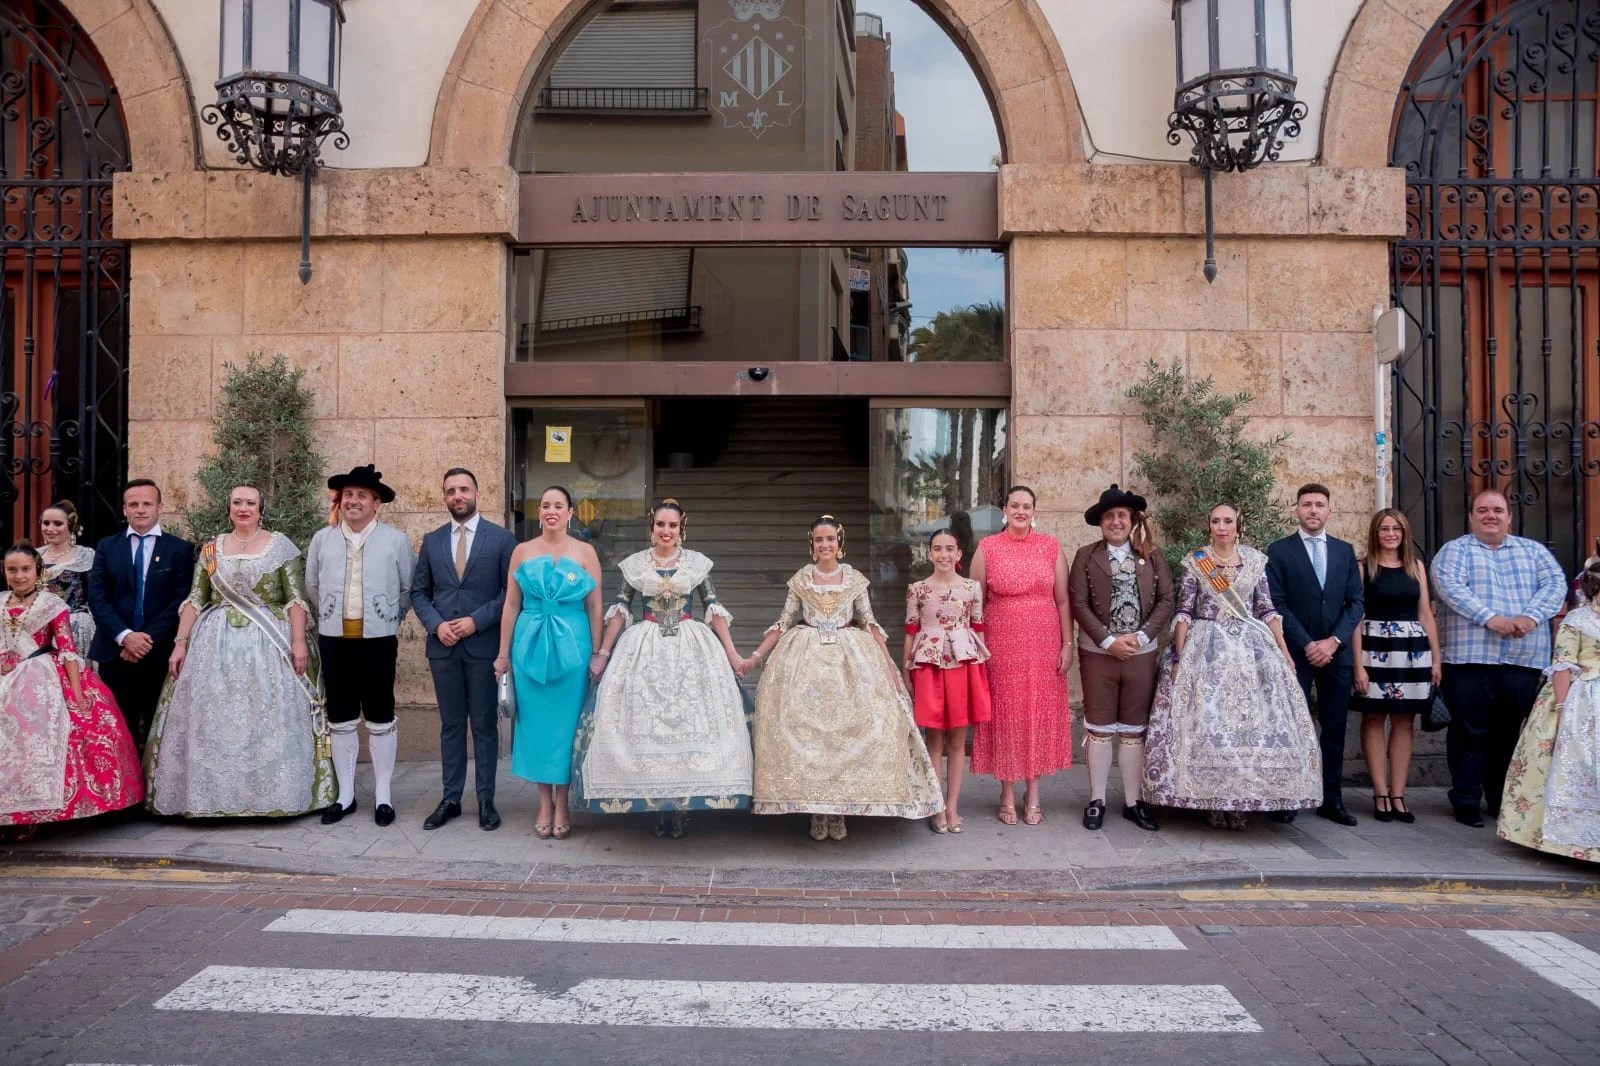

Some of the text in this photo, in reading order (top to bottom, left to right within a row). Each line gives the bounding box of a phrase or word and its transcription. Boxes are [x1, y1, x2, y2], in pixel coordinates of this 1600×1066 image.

[719, 90, 792, 108] M L
[571, 194, 948, 223] AJUNTAMENT DE SAGUNT
